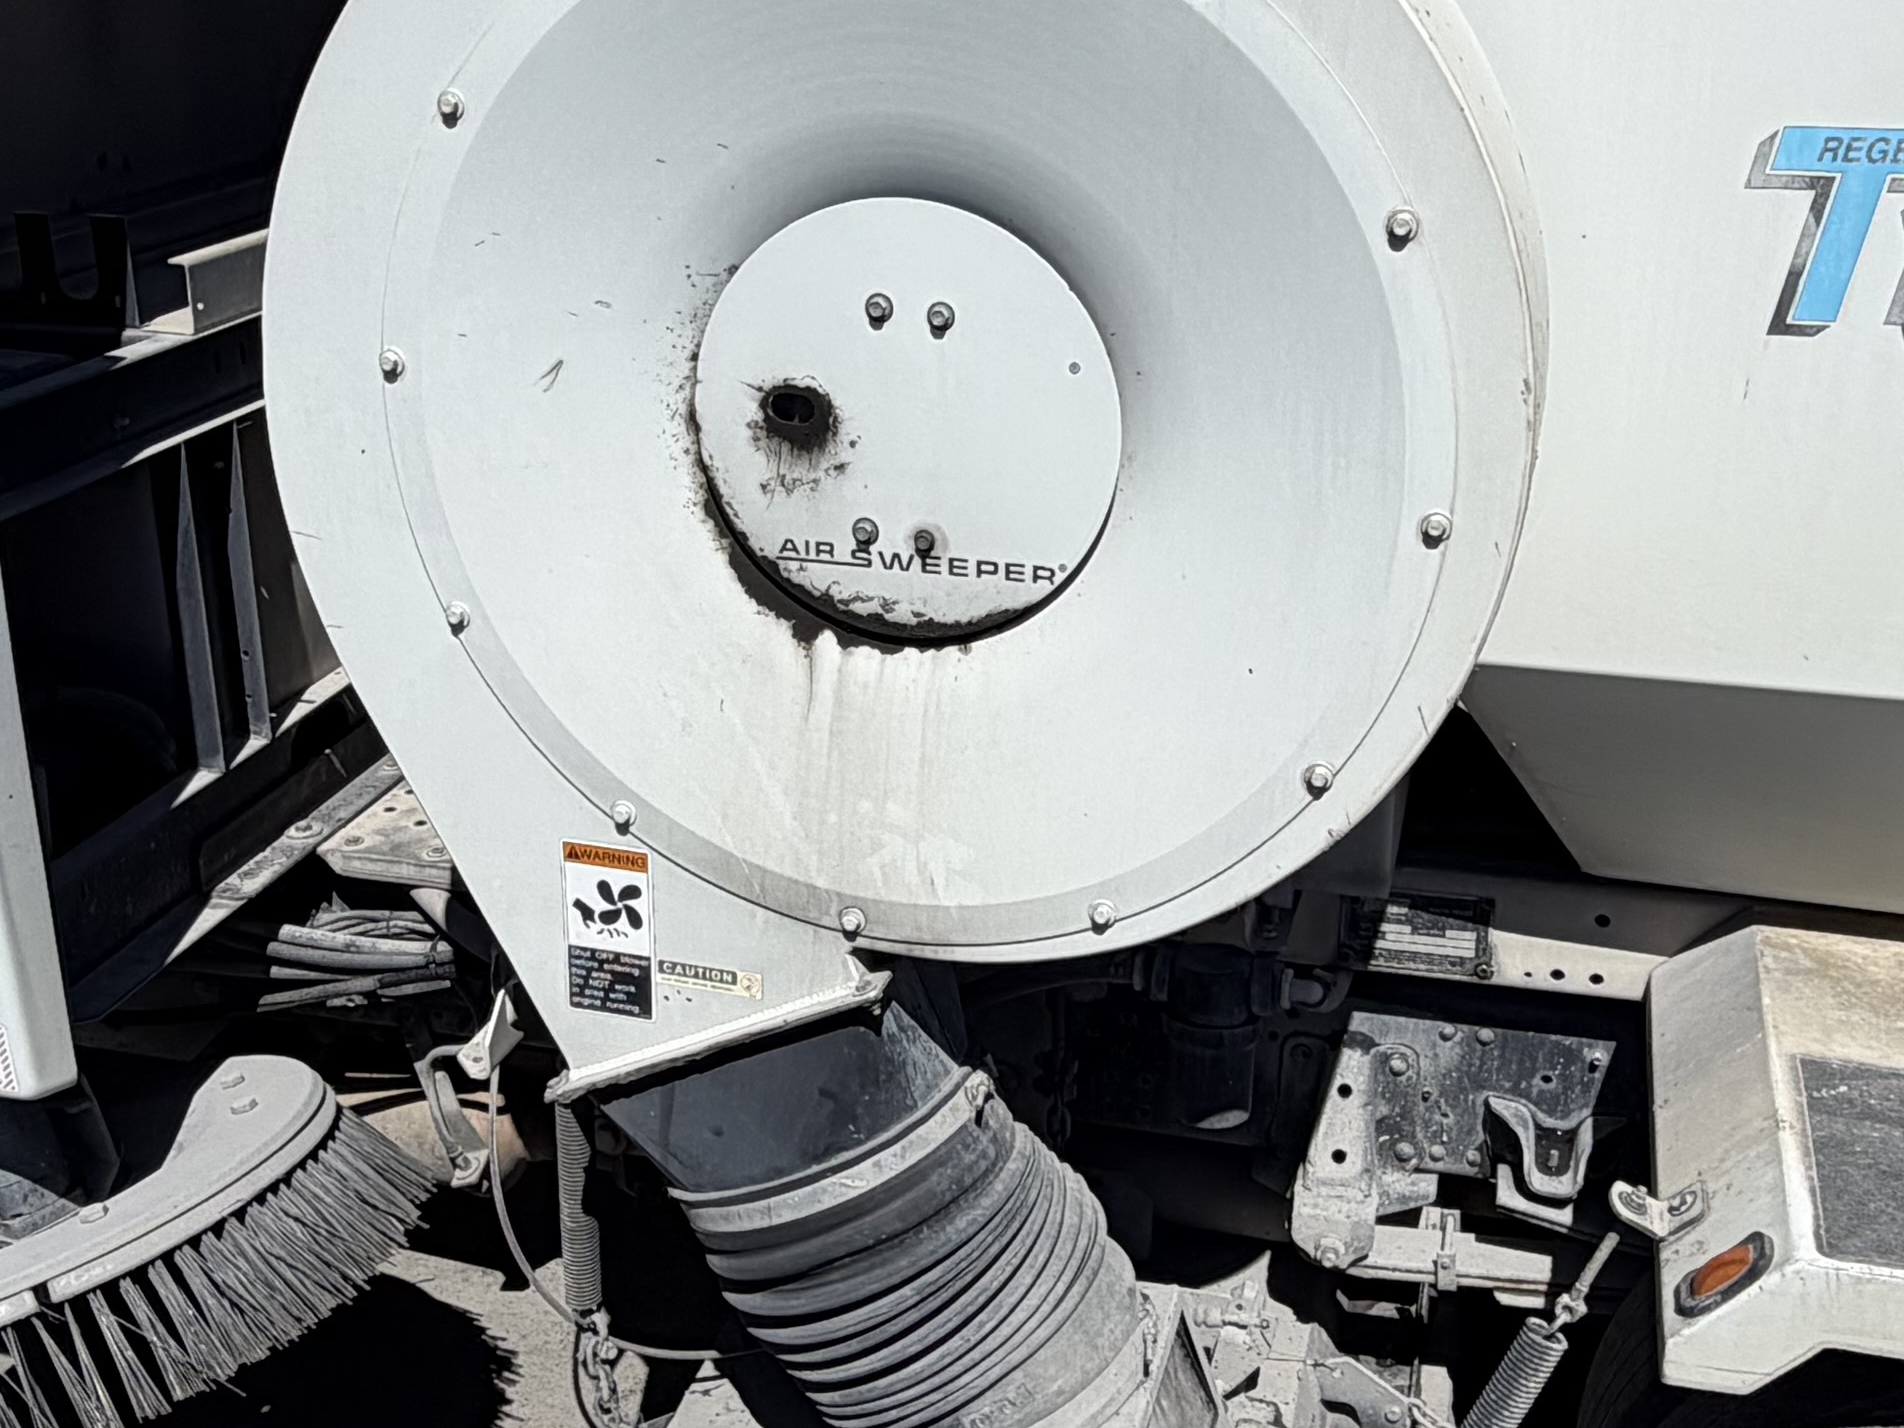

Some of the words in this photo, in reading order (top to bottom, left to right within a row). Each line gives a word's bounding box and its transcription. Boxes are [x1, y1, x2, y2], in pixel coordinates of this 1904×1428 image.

[778, 537, 836, 562] AIR
[850, 545, 1056, 586] SWEEPER
[581, 848, 646, 870] WARNING
[662, 962, 733, 983] CAUTION
